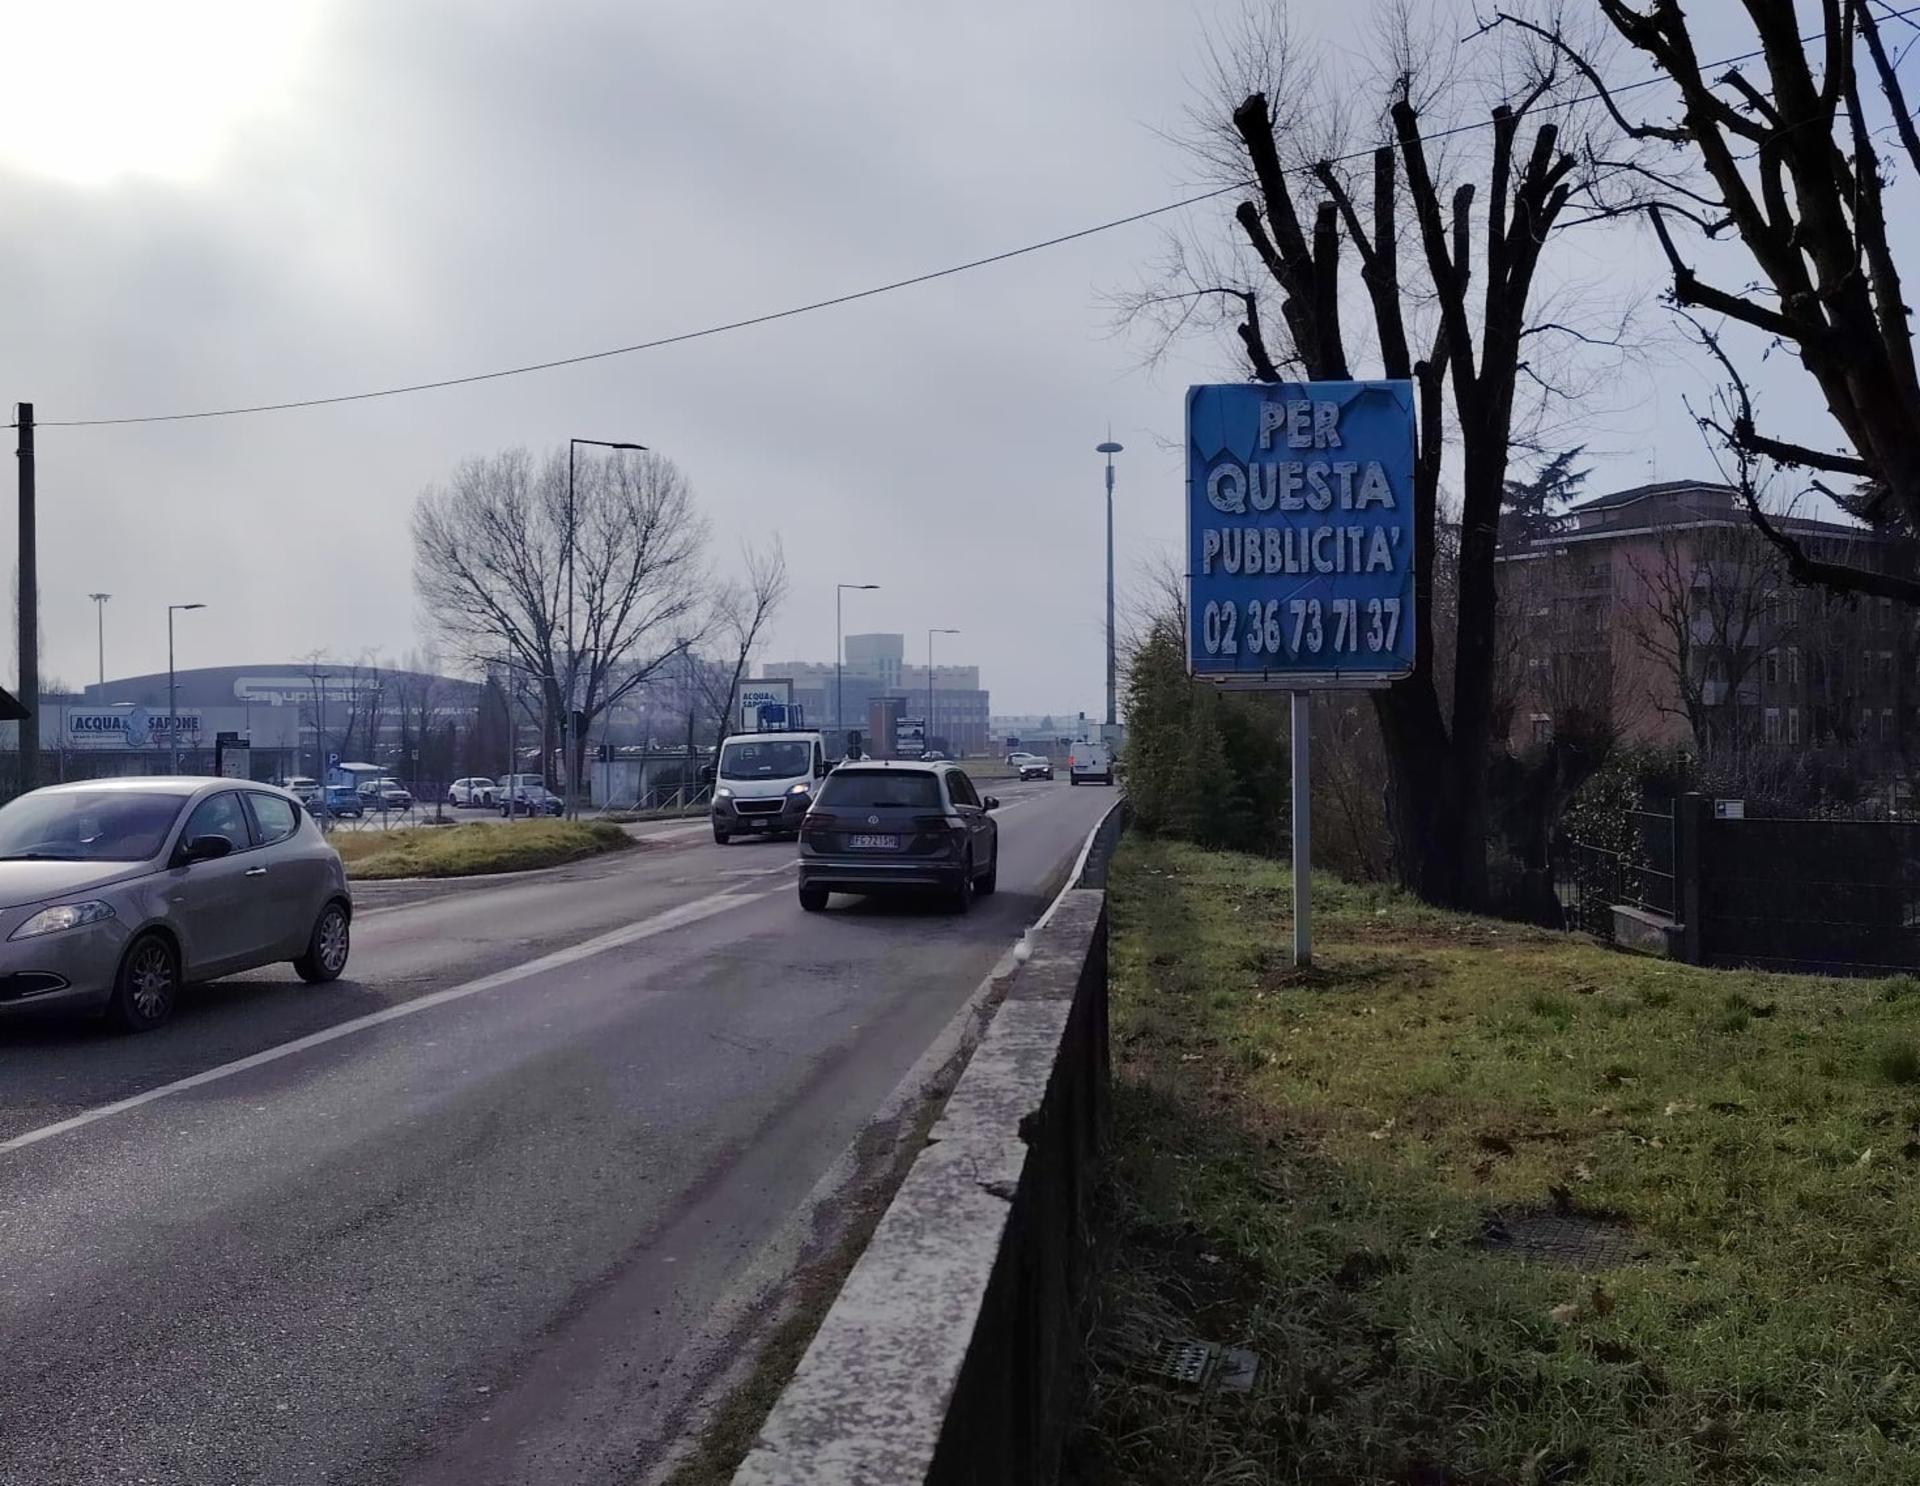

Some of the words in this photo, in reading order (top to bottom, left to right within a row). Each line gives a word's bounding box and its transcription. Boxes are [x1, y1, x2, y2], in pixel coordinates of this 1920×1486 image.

[1259, 399, 1342, 449] PER
[1207, 460, 1396, 514] QUESTA
[1203, 525, 1400, 574] PUBBLICITA'
[1203, 600, 1237, 654] 02
[1247, 600, 1281, 653] 36
[1290, 599, 1323, 652] 73
[1332, 599, 1357, 651] 71
[1367, 598, 1400, 651] 37
[743, 692, 769, 701] ACQUA
[75, 717, 120, 730] ACQUA
